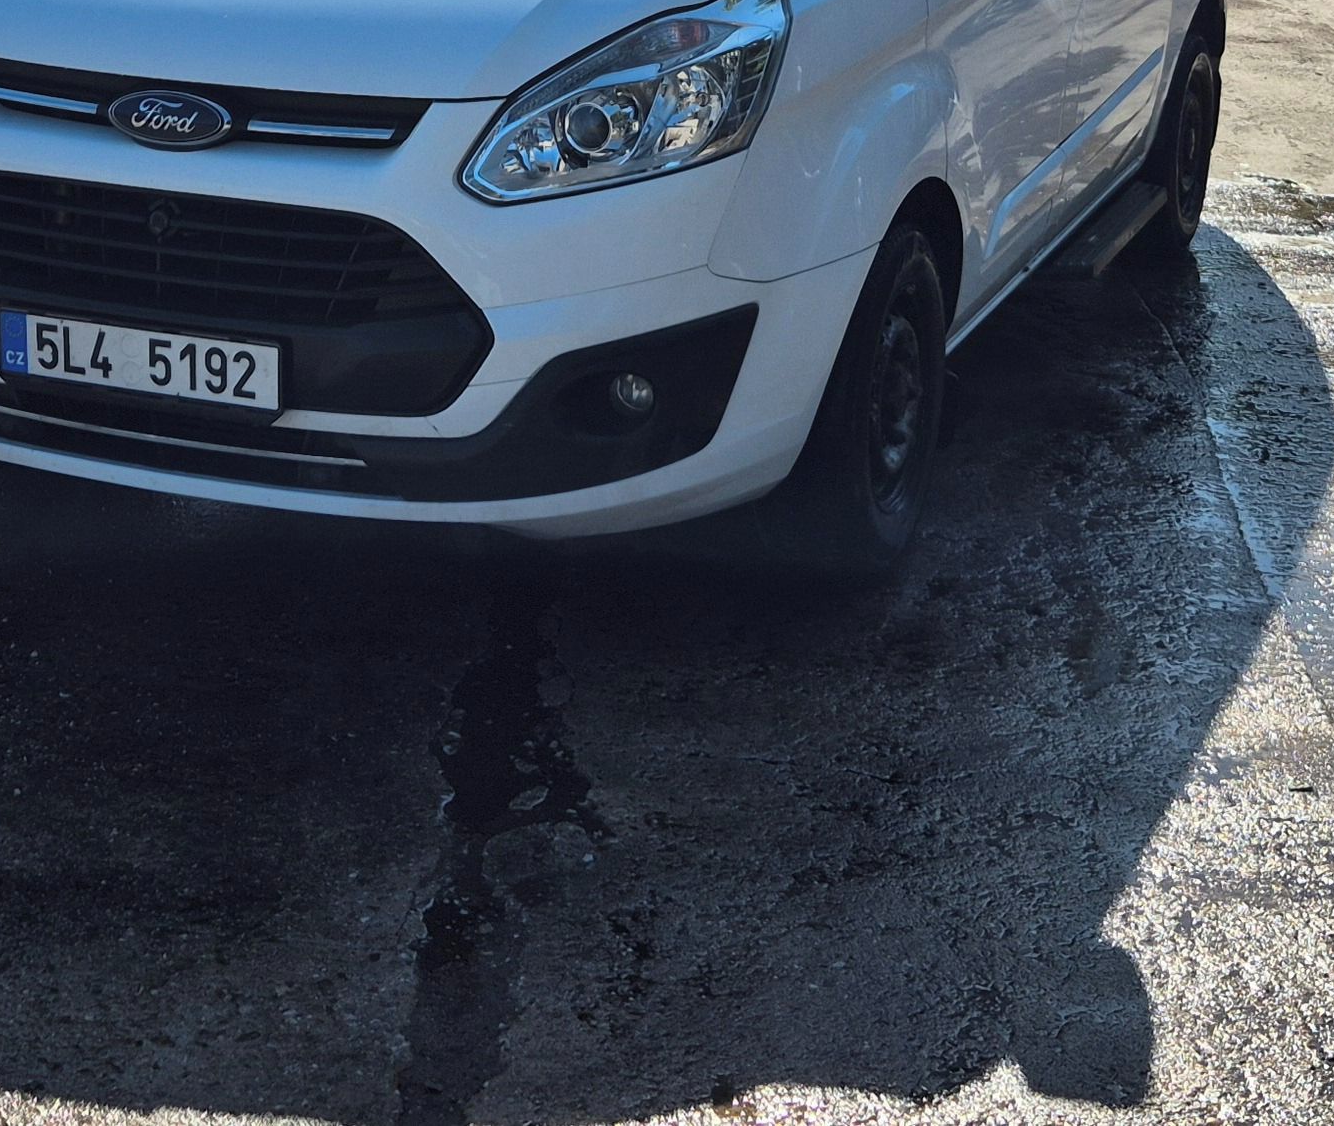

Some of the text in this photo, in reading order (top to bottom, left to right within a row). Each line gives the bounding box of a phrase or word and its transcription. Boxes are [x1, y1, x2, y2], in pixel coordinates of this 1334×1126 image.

[131, 97, 199, 133] Ford
[5, 349, 25, 366] CZ
[35, 322, 257, 400] 5L4 5192
